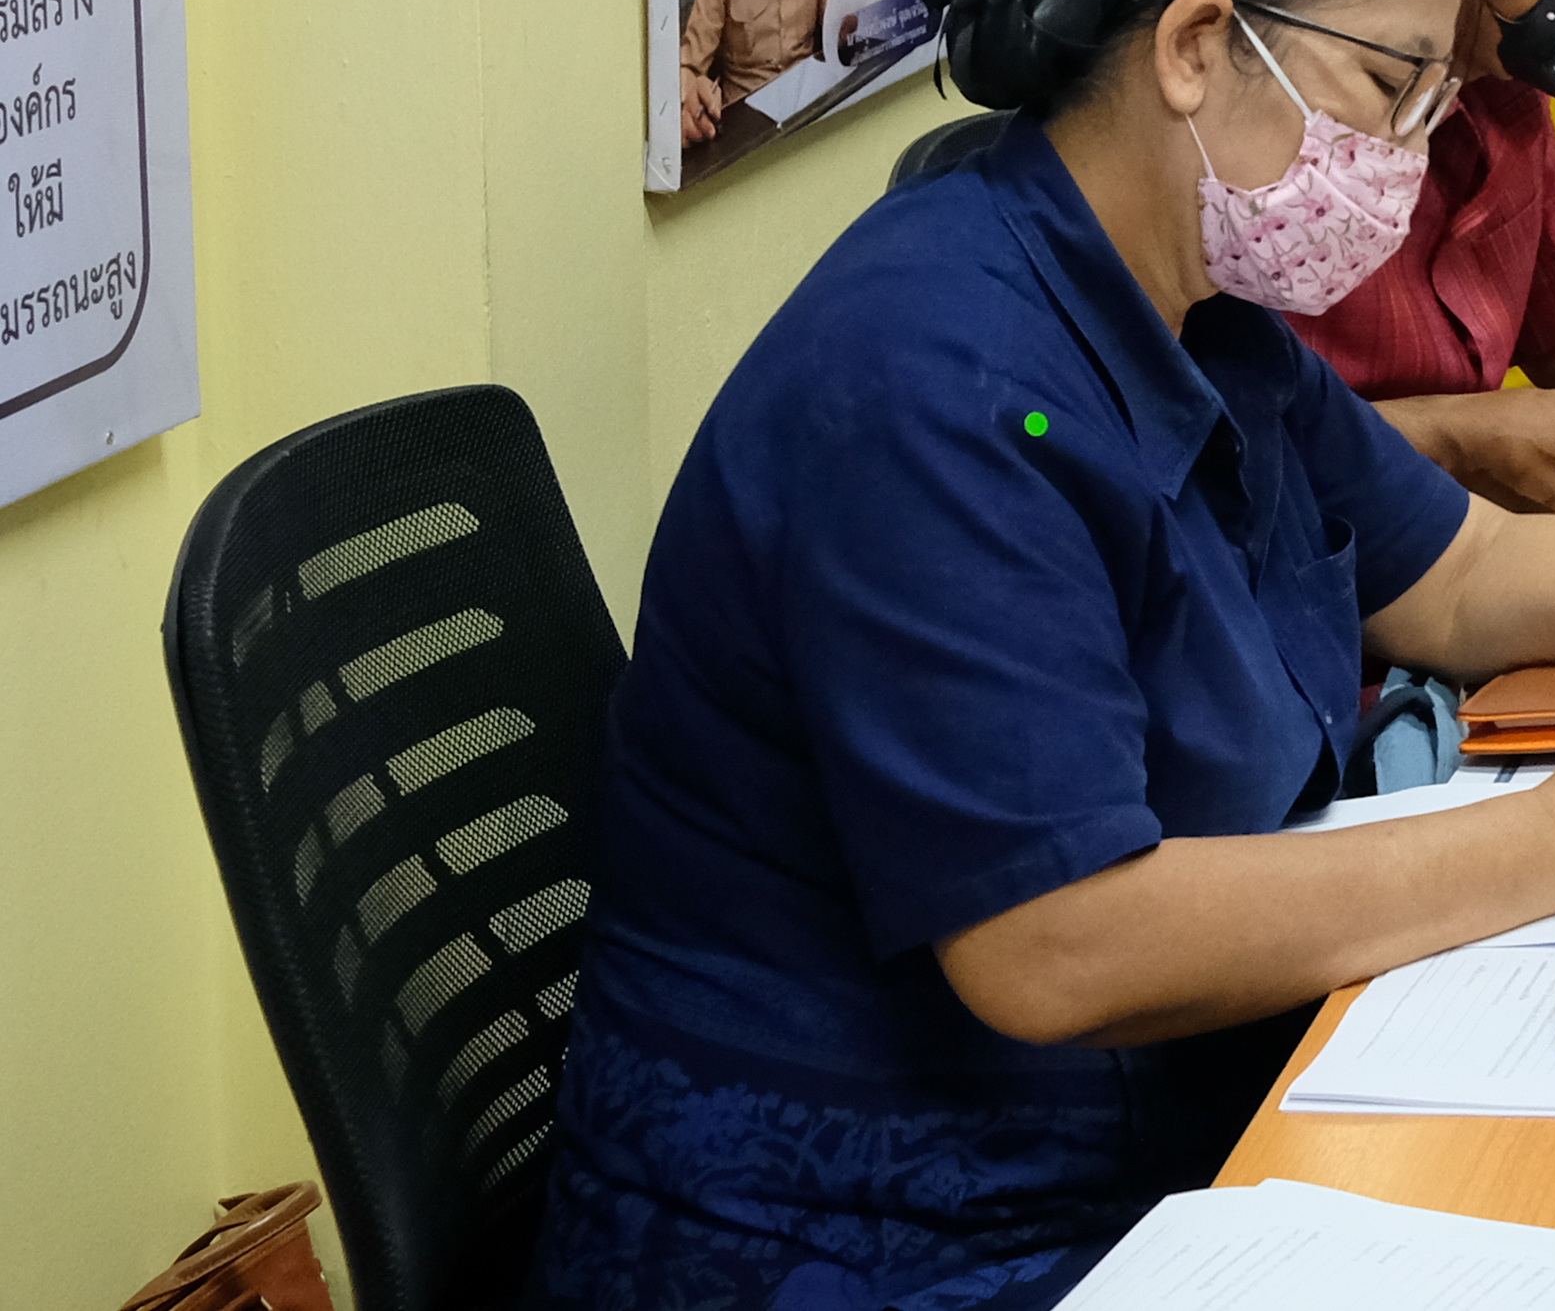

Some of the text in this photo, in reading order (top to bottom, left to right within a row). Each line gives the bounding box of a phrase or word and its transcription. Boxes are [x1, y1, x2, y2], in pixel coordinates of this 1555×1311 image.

[8, 158, 64, 238] ให้มี
[1, 251, 137, 346] มรรถนะสูง
